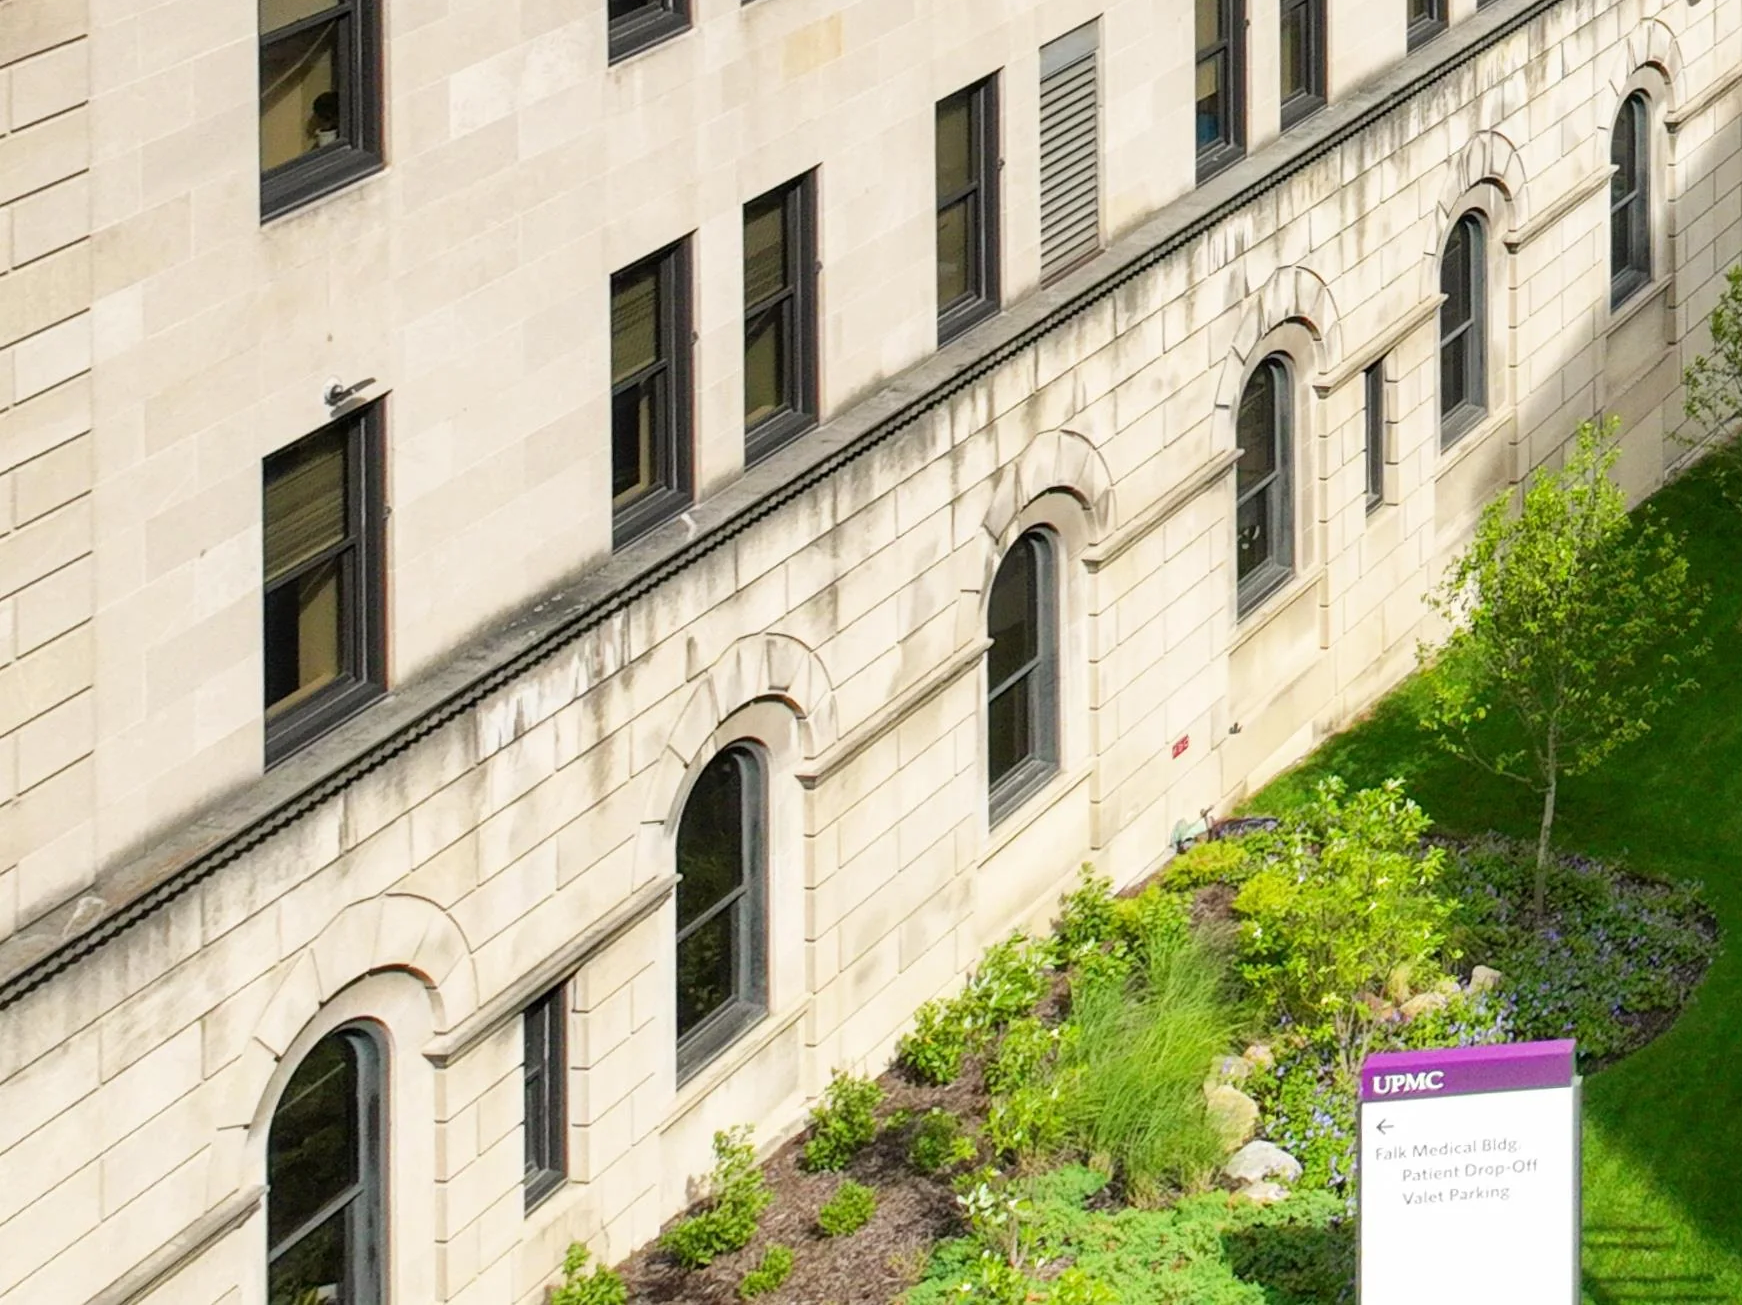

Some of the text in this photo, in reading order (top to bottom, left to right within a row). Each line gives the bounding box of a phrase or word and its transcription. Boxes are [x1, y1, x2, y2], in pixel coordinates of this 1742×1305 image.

[1372, 1071, 1445, 1095] UPMC
[1375, 1143, 1407, 1161] Falk
[1412, 1140, 1477, 1158] Medical
[1402, 1158, 1539, 1182] Patient Drop-Off
[1402, 1186, 1511, 1206] Valet Parking
